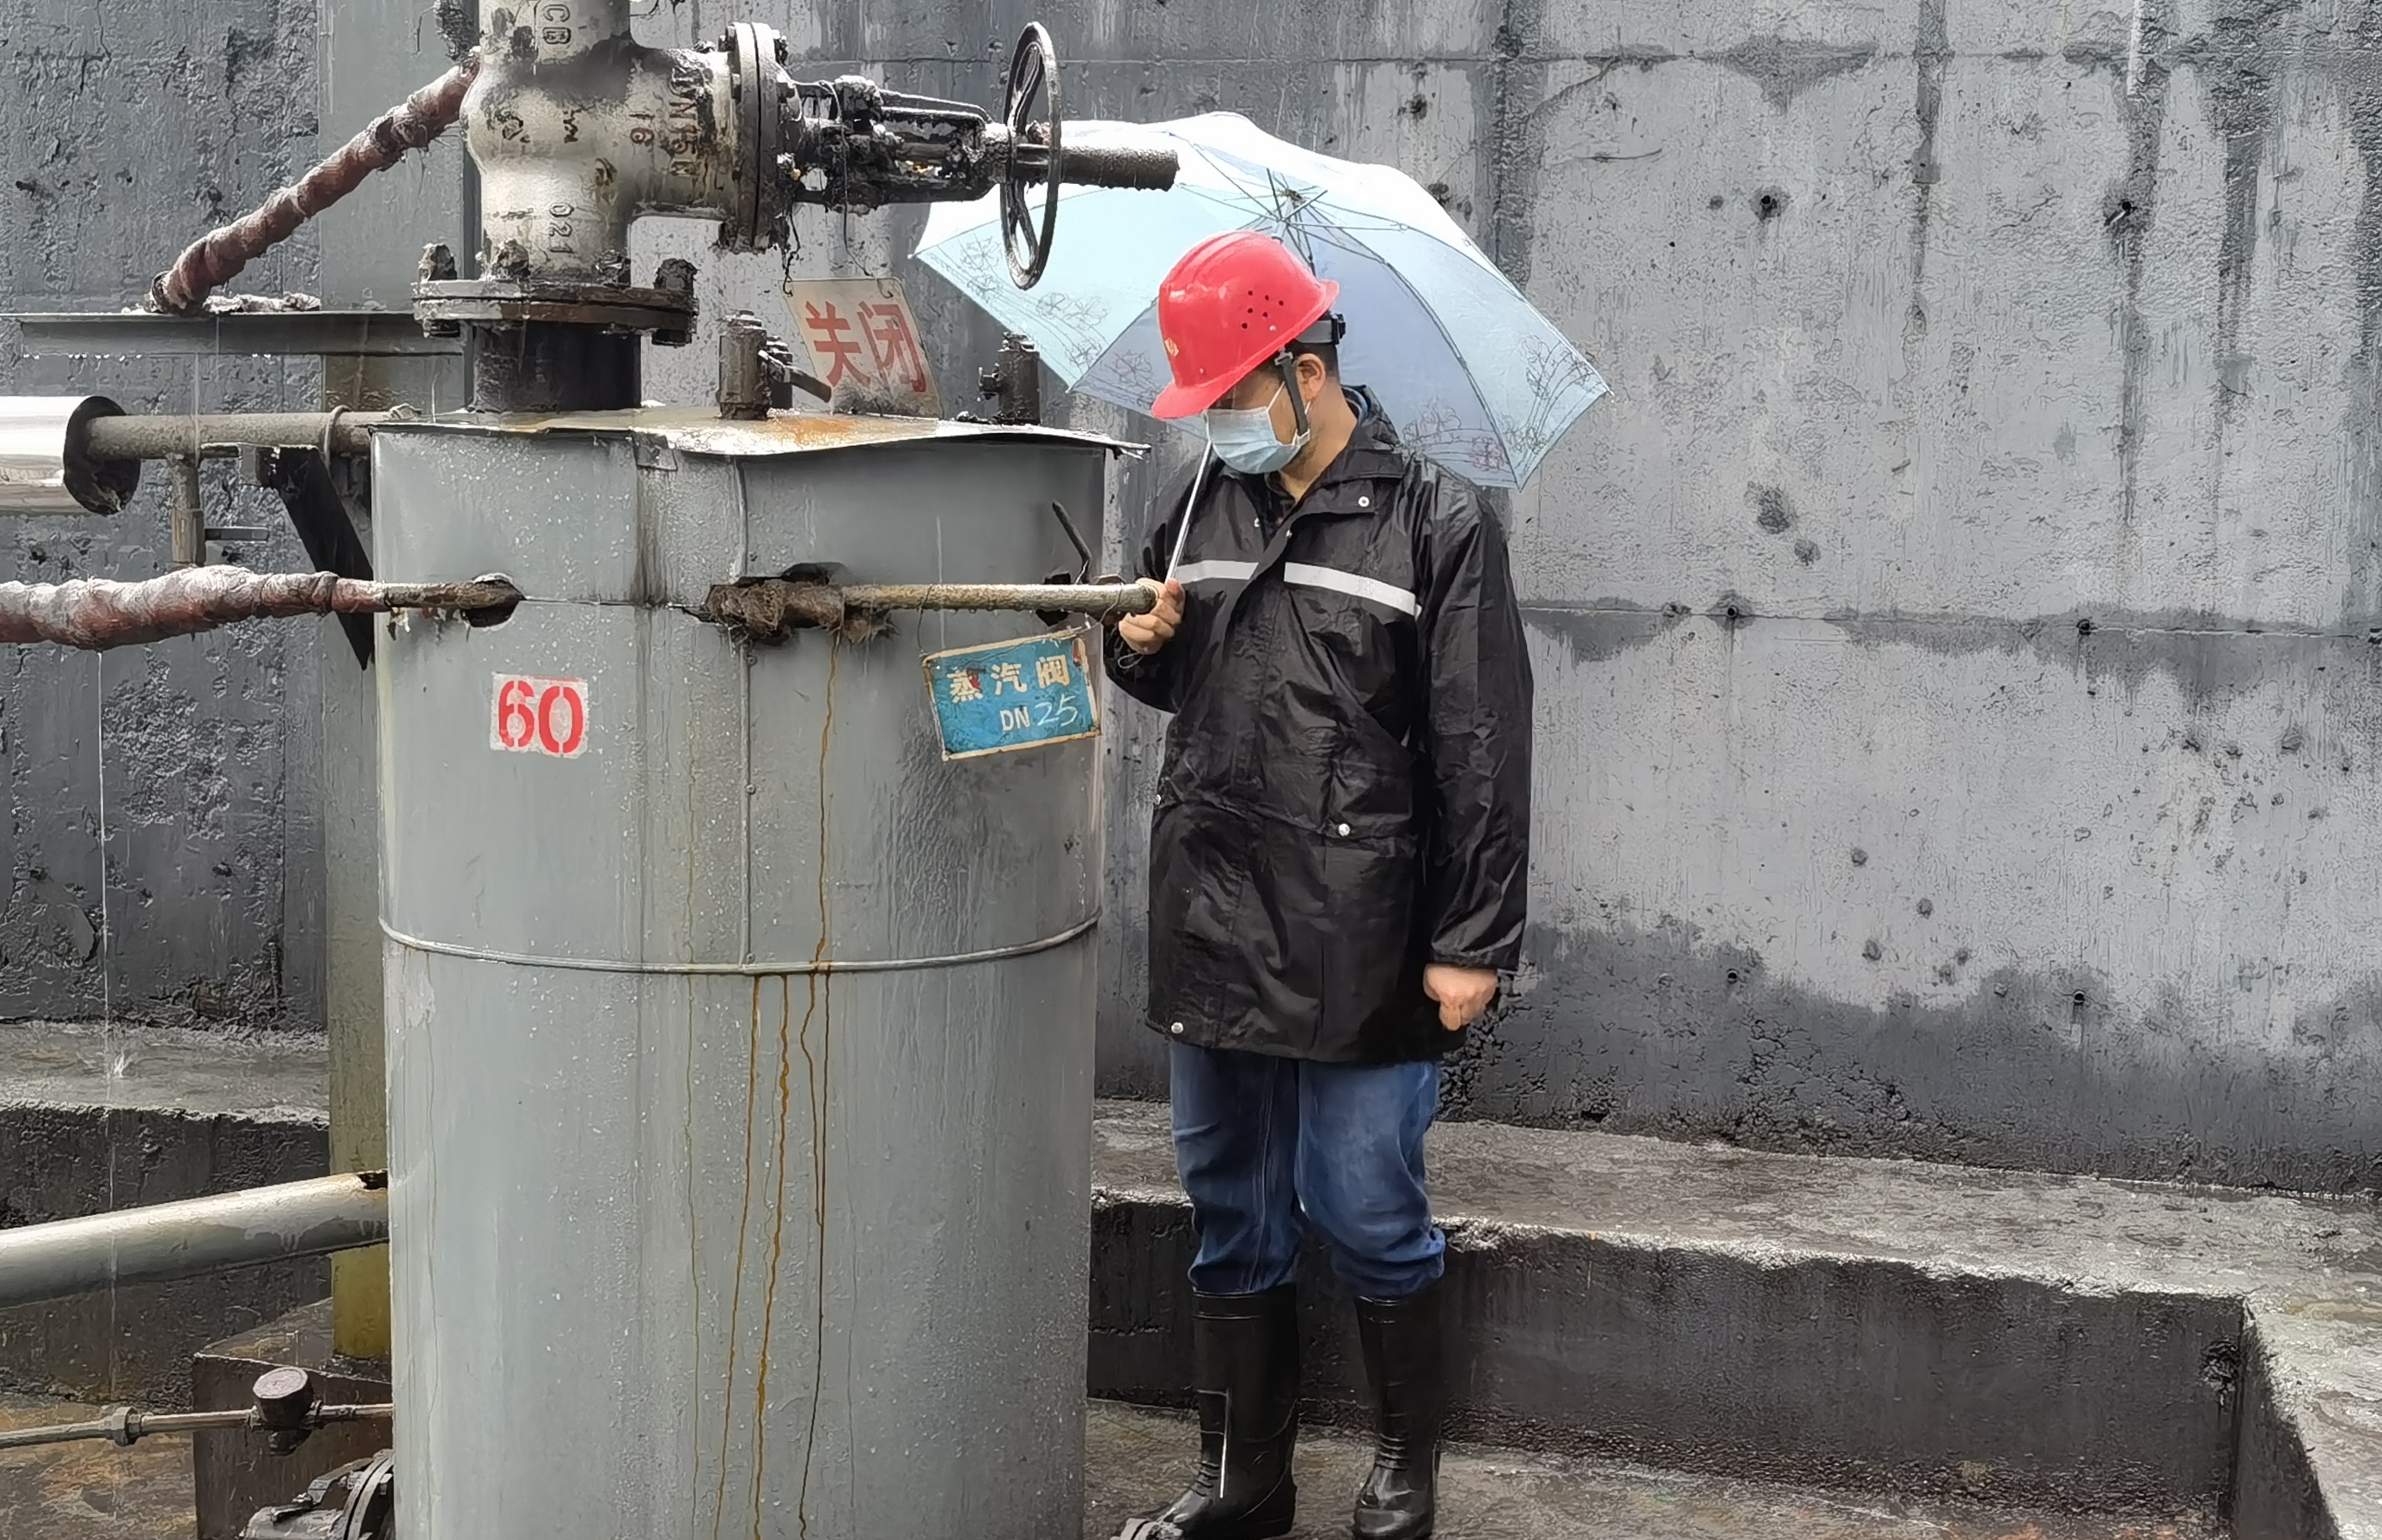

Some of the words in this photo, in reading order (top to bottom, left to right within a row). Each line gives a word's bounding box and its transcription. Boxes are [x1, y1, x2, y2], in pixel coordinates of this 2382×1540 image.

[549, 202, 574, 254] 021
[805, 301, 926, 393] 关闭
[946, 654, 1071, 704] 蒸汽阀
[498, 681, 584, 755] 60
[999, 706, 1030, 731] DN
[1034, 694, 1078, 727] 25
